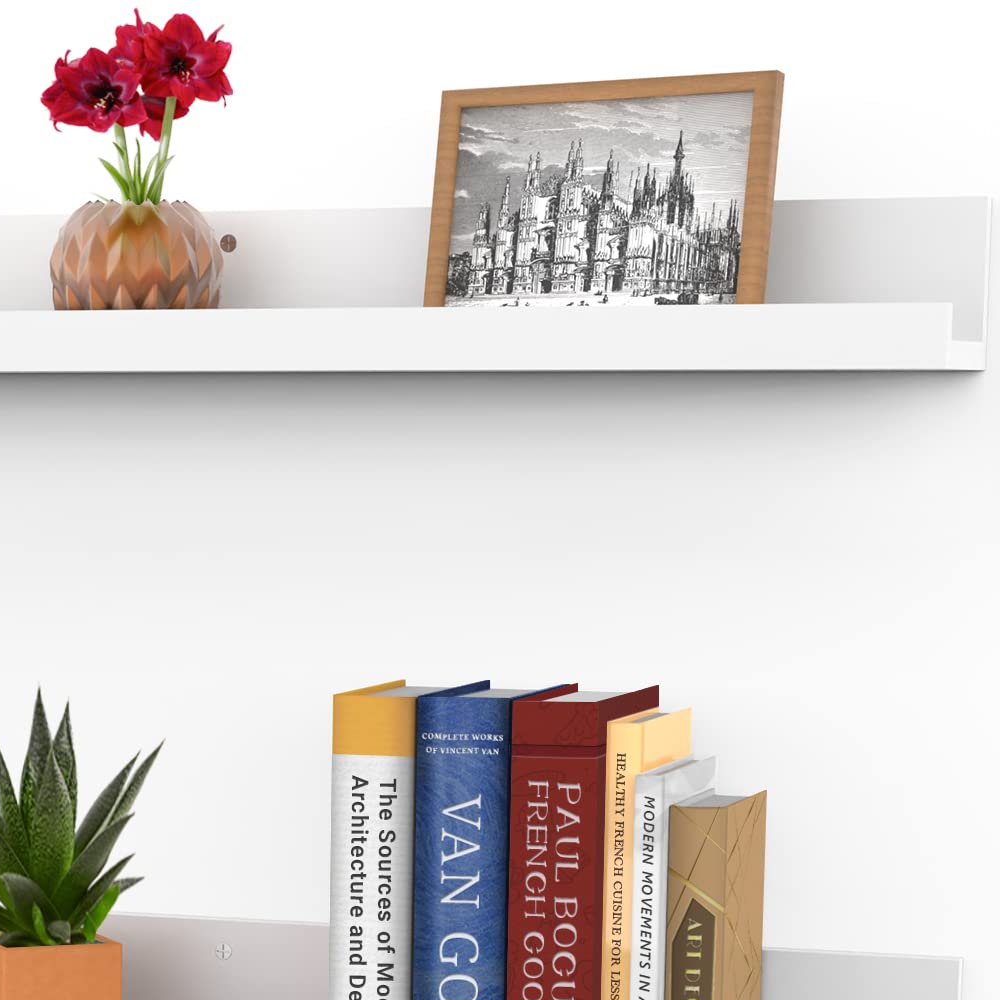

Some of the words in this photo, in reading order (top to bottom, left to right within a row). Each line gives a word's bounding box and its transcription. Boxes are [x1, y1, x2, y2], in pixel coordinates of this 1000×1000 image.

[421, 732, 469, 742] COMPLETE
[471, 733, 504, 742] WORKS
[425, 746, 438, 754] OF
[440, 747, 480, 755] VINCENT
[481, 747, 500, 756] VAN
[379, 778, 398, 821] The
[615, 752, 627, 817] HEALTHY
[349, 774, 370, 918] Architecture
[439, 793, 482, 910] VAN
[524, 780, 549, 919] FRENCH
[554, 782, 582, 883] PAUL
[613, 821, 625, 877] FRENCH
[642, 795, 656, 865] MODERN
[377, 829, 397, 922] Sources
[611, 880, 623, 936] CUISINE
[639, 871, 654, 970] MOVEMENTS
[348, 925, 368, 966] and
[377, 931, 396, 954] of
[610, 939, 622, 968] FOR
[686, 917, 703, 960] ART
[610, 970, 621, 1000] LESS
[638, 974, 651, 992] IN
